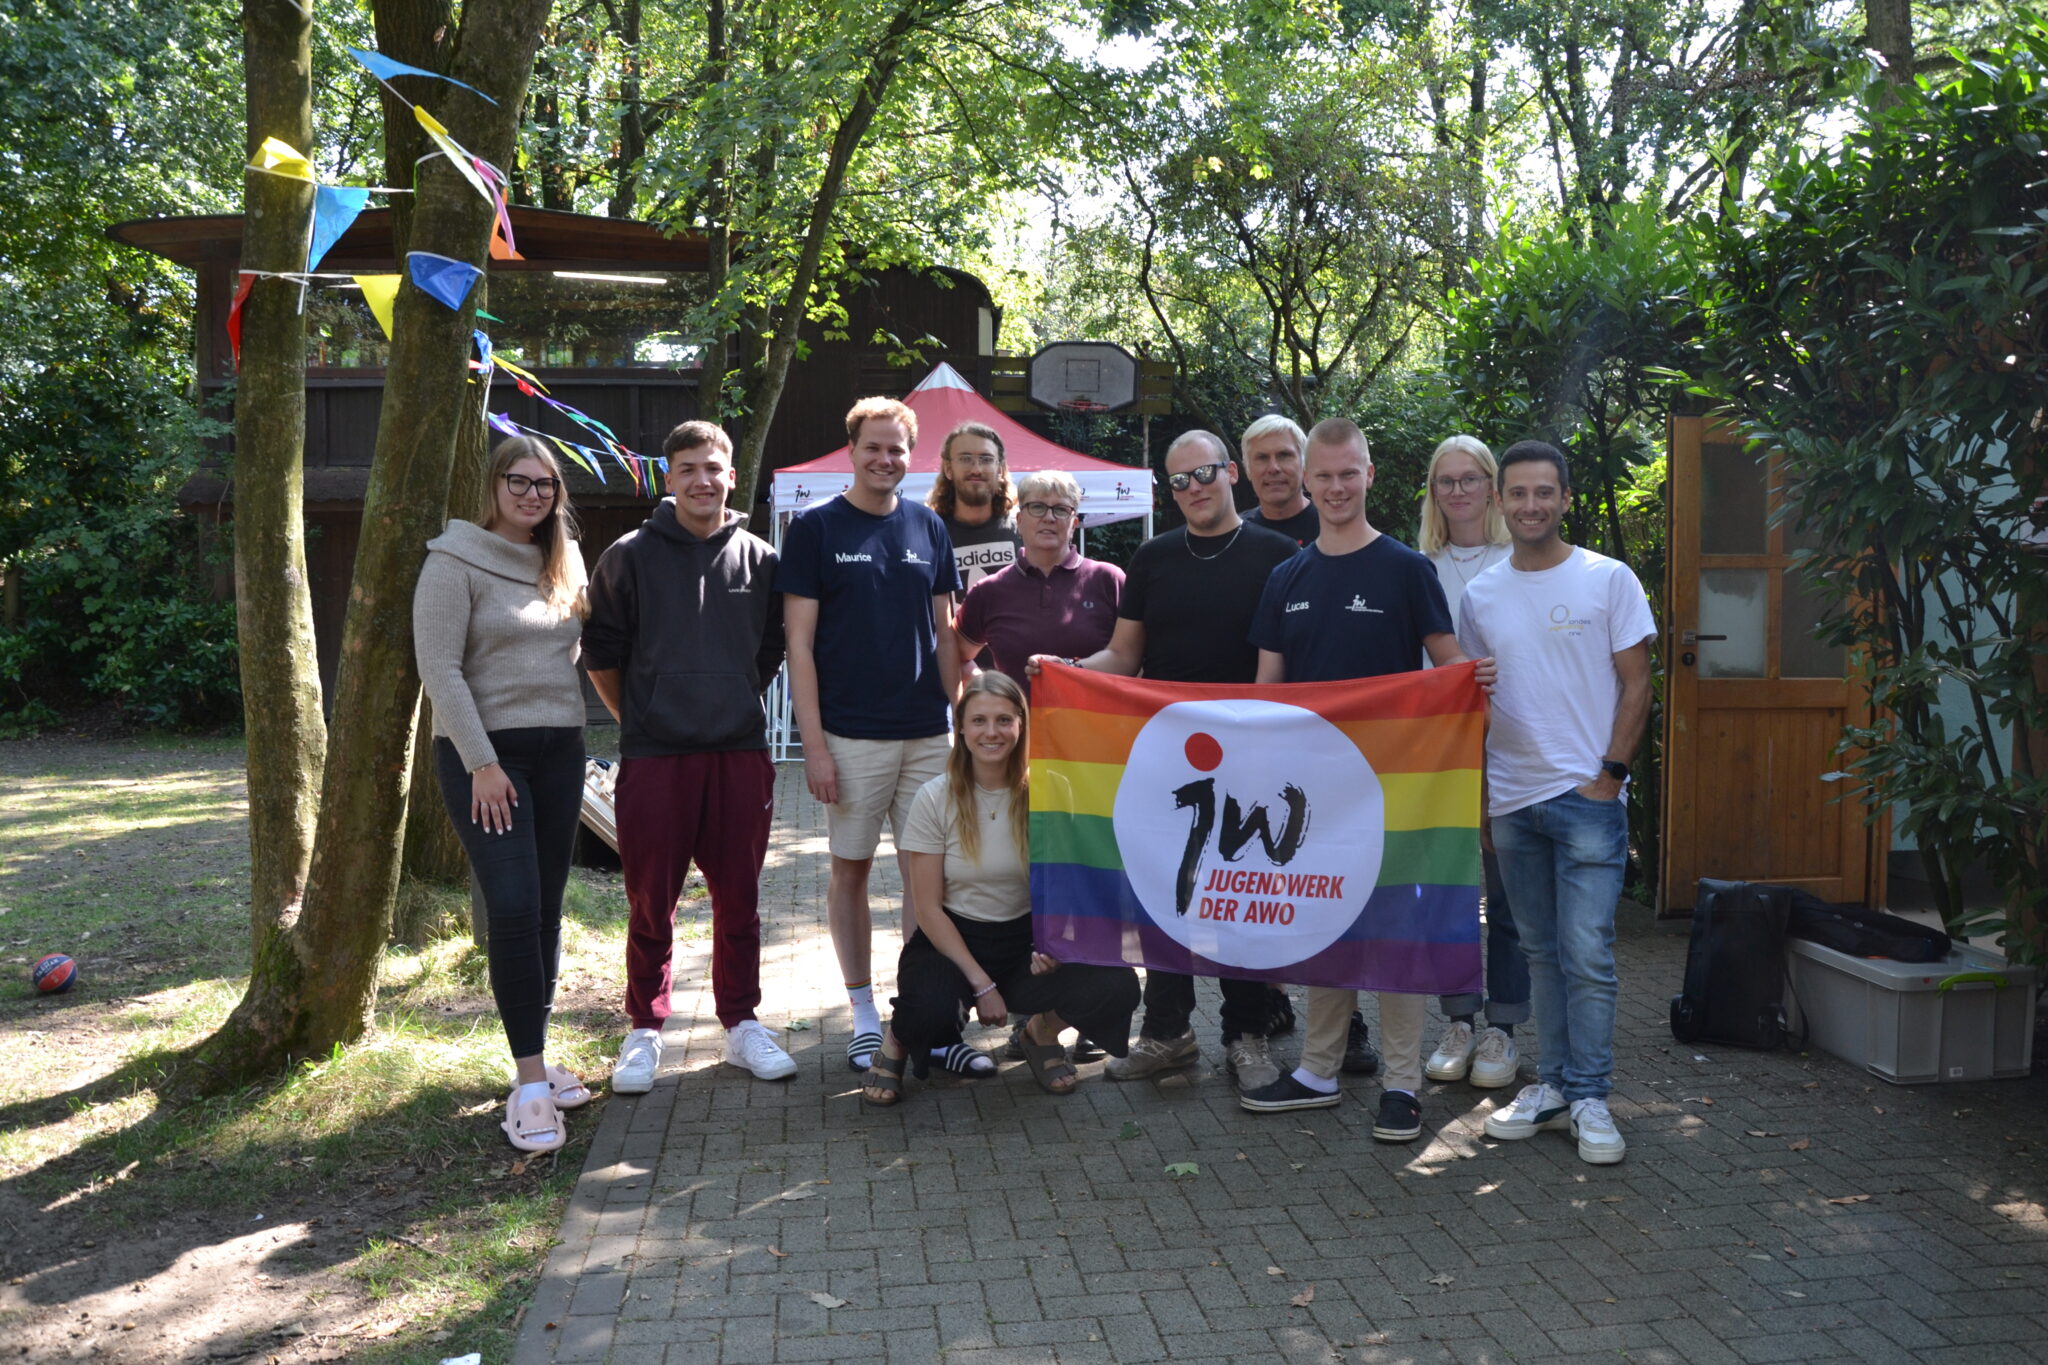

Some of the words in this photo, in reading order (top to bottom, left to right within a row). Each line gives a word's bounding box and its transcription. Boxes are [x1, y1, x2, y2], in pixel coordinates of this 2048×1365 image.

[835, 552, 872, 563] Maurice
[1285, 601, 1310, 613] Lucas
[1203, 868, 1345, 900] JUGENDWERK
[1198, 897, 1239, 923] DER
[1243, 900, 1296, 926] AWO
